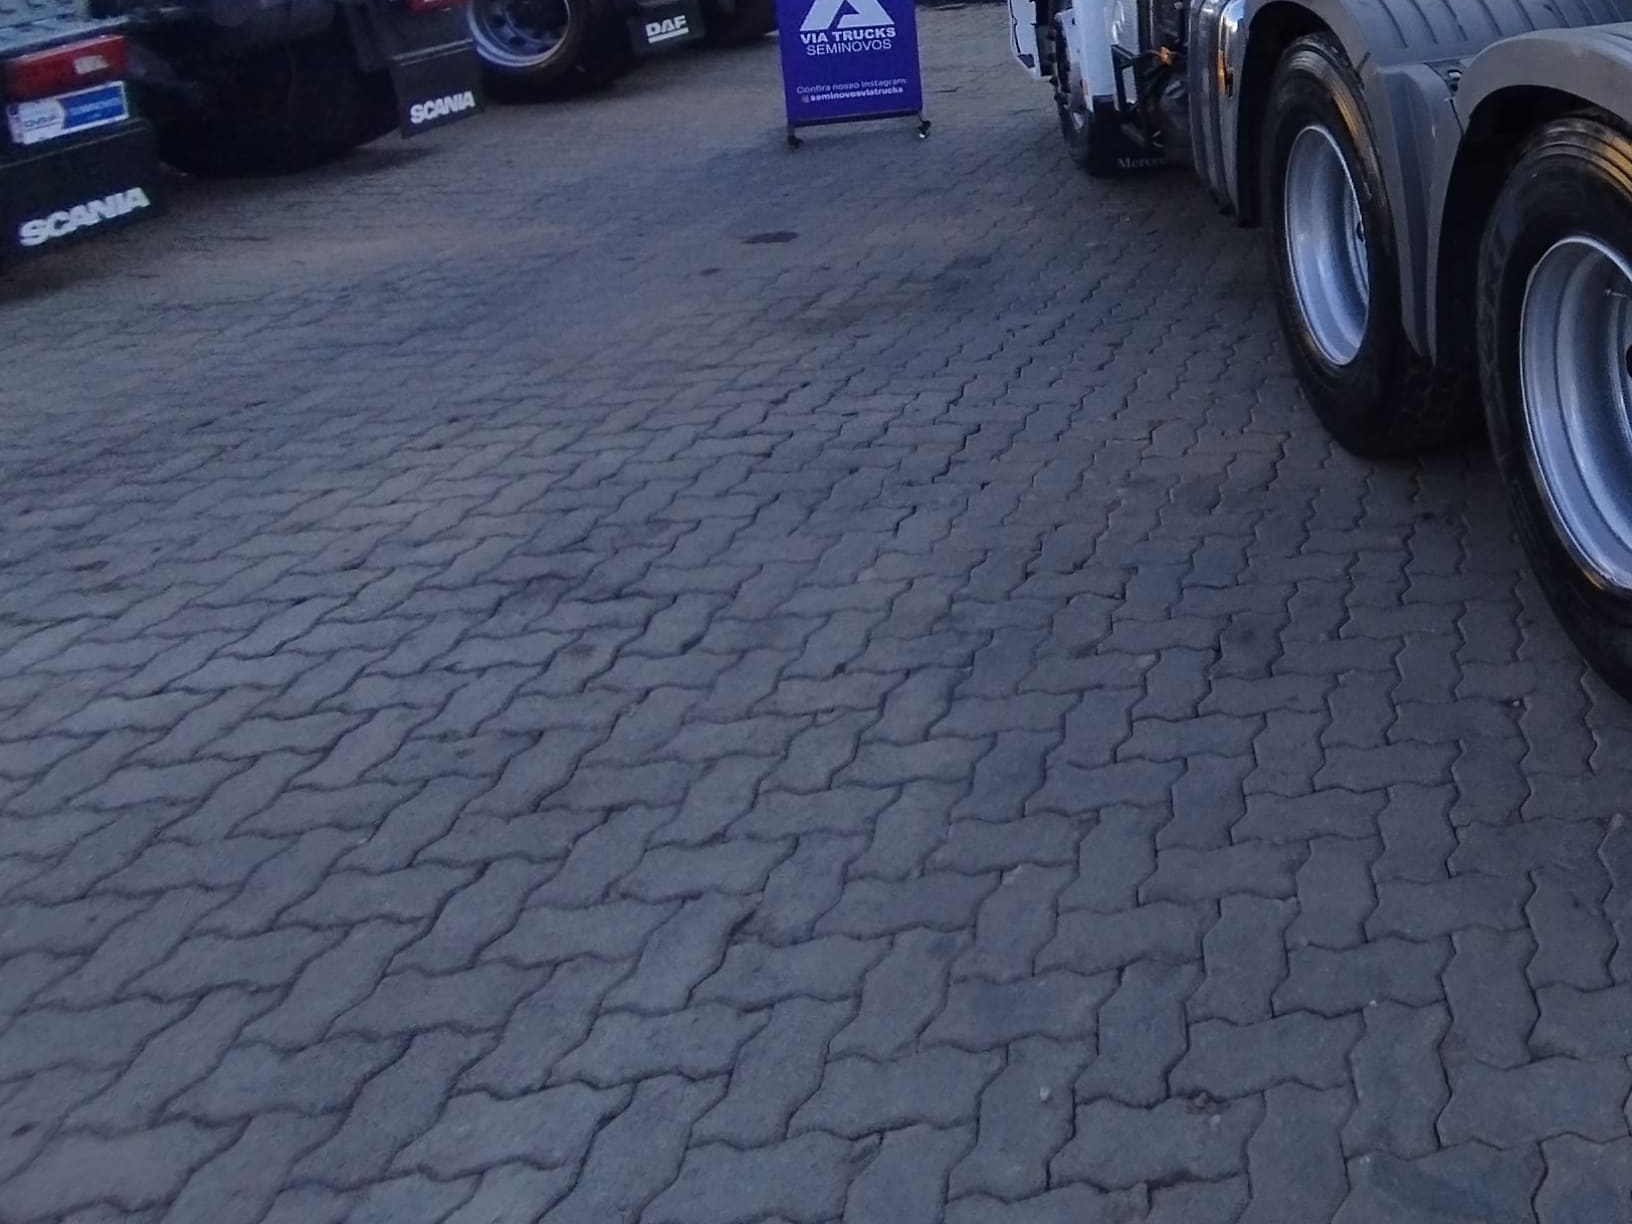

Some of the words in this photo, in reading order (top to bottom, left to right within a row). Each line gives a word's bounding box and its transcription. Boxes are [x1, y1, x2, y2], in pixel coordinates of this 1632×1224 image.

[645, 15, 687, 36] DAF
[800, 32, 829, 45] VIA
[832, 27, 897, 42] TRUCKS
[806, 39, 892, 56] SEMINOVOS
[410, 90, 476, 124] SCANIA
[18, 187, 151, 247] SCANIA
